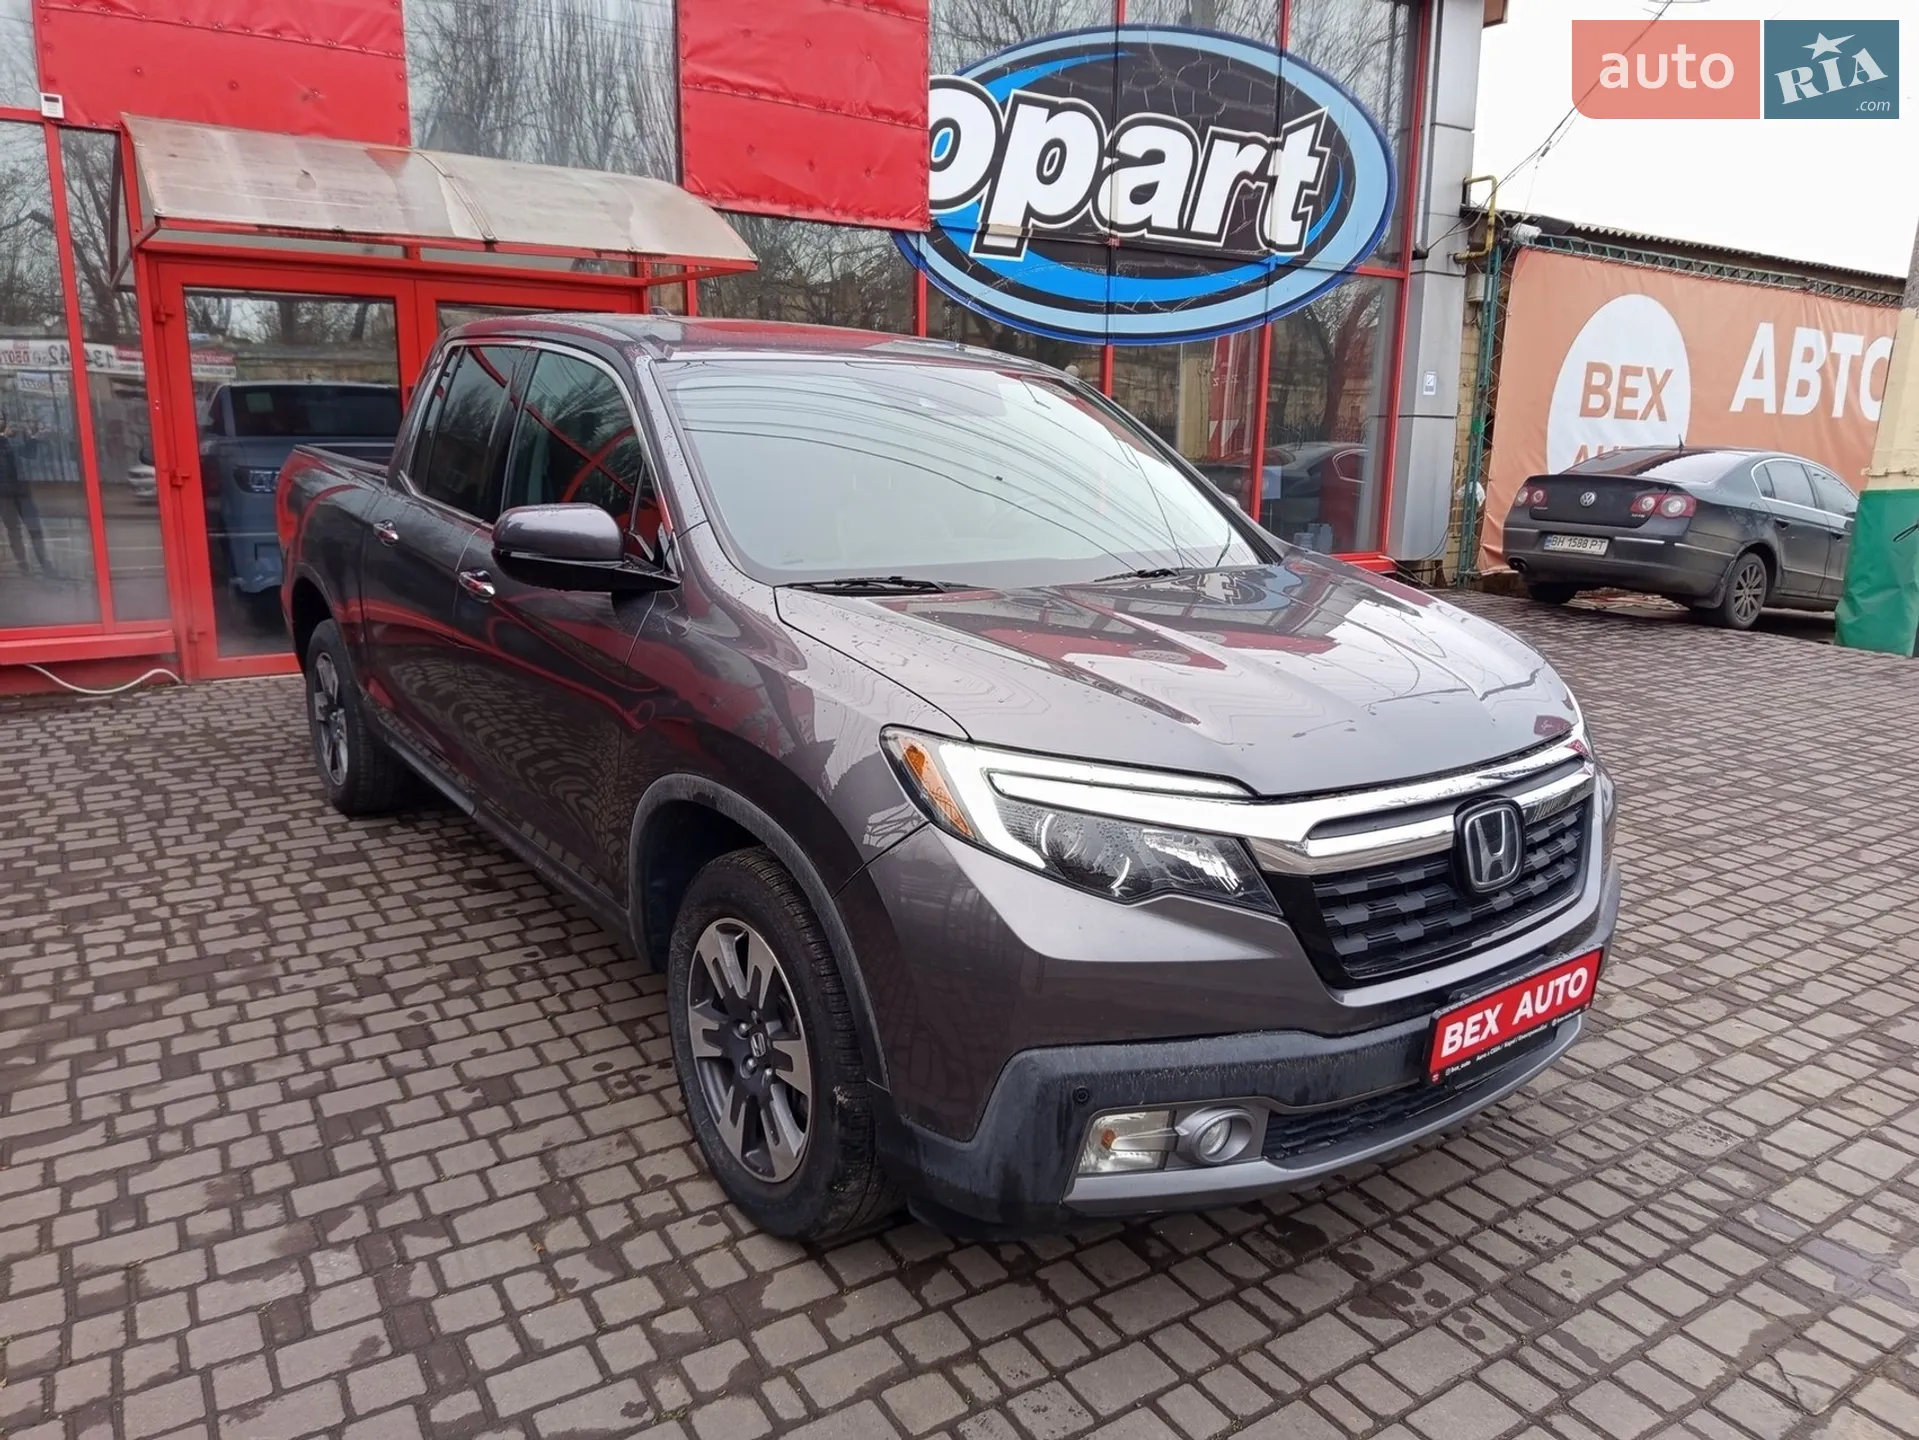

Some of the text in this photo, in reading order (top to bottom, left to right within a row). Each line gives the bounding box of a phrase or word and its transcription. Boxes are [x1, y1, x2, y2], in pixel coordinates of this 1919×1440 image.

[1578, 361, 1675, 423] BEX
[1551, 536, 1607, 550] BH 1588 PT
[1441, 967, 1588, 1059] BEX AUTO
